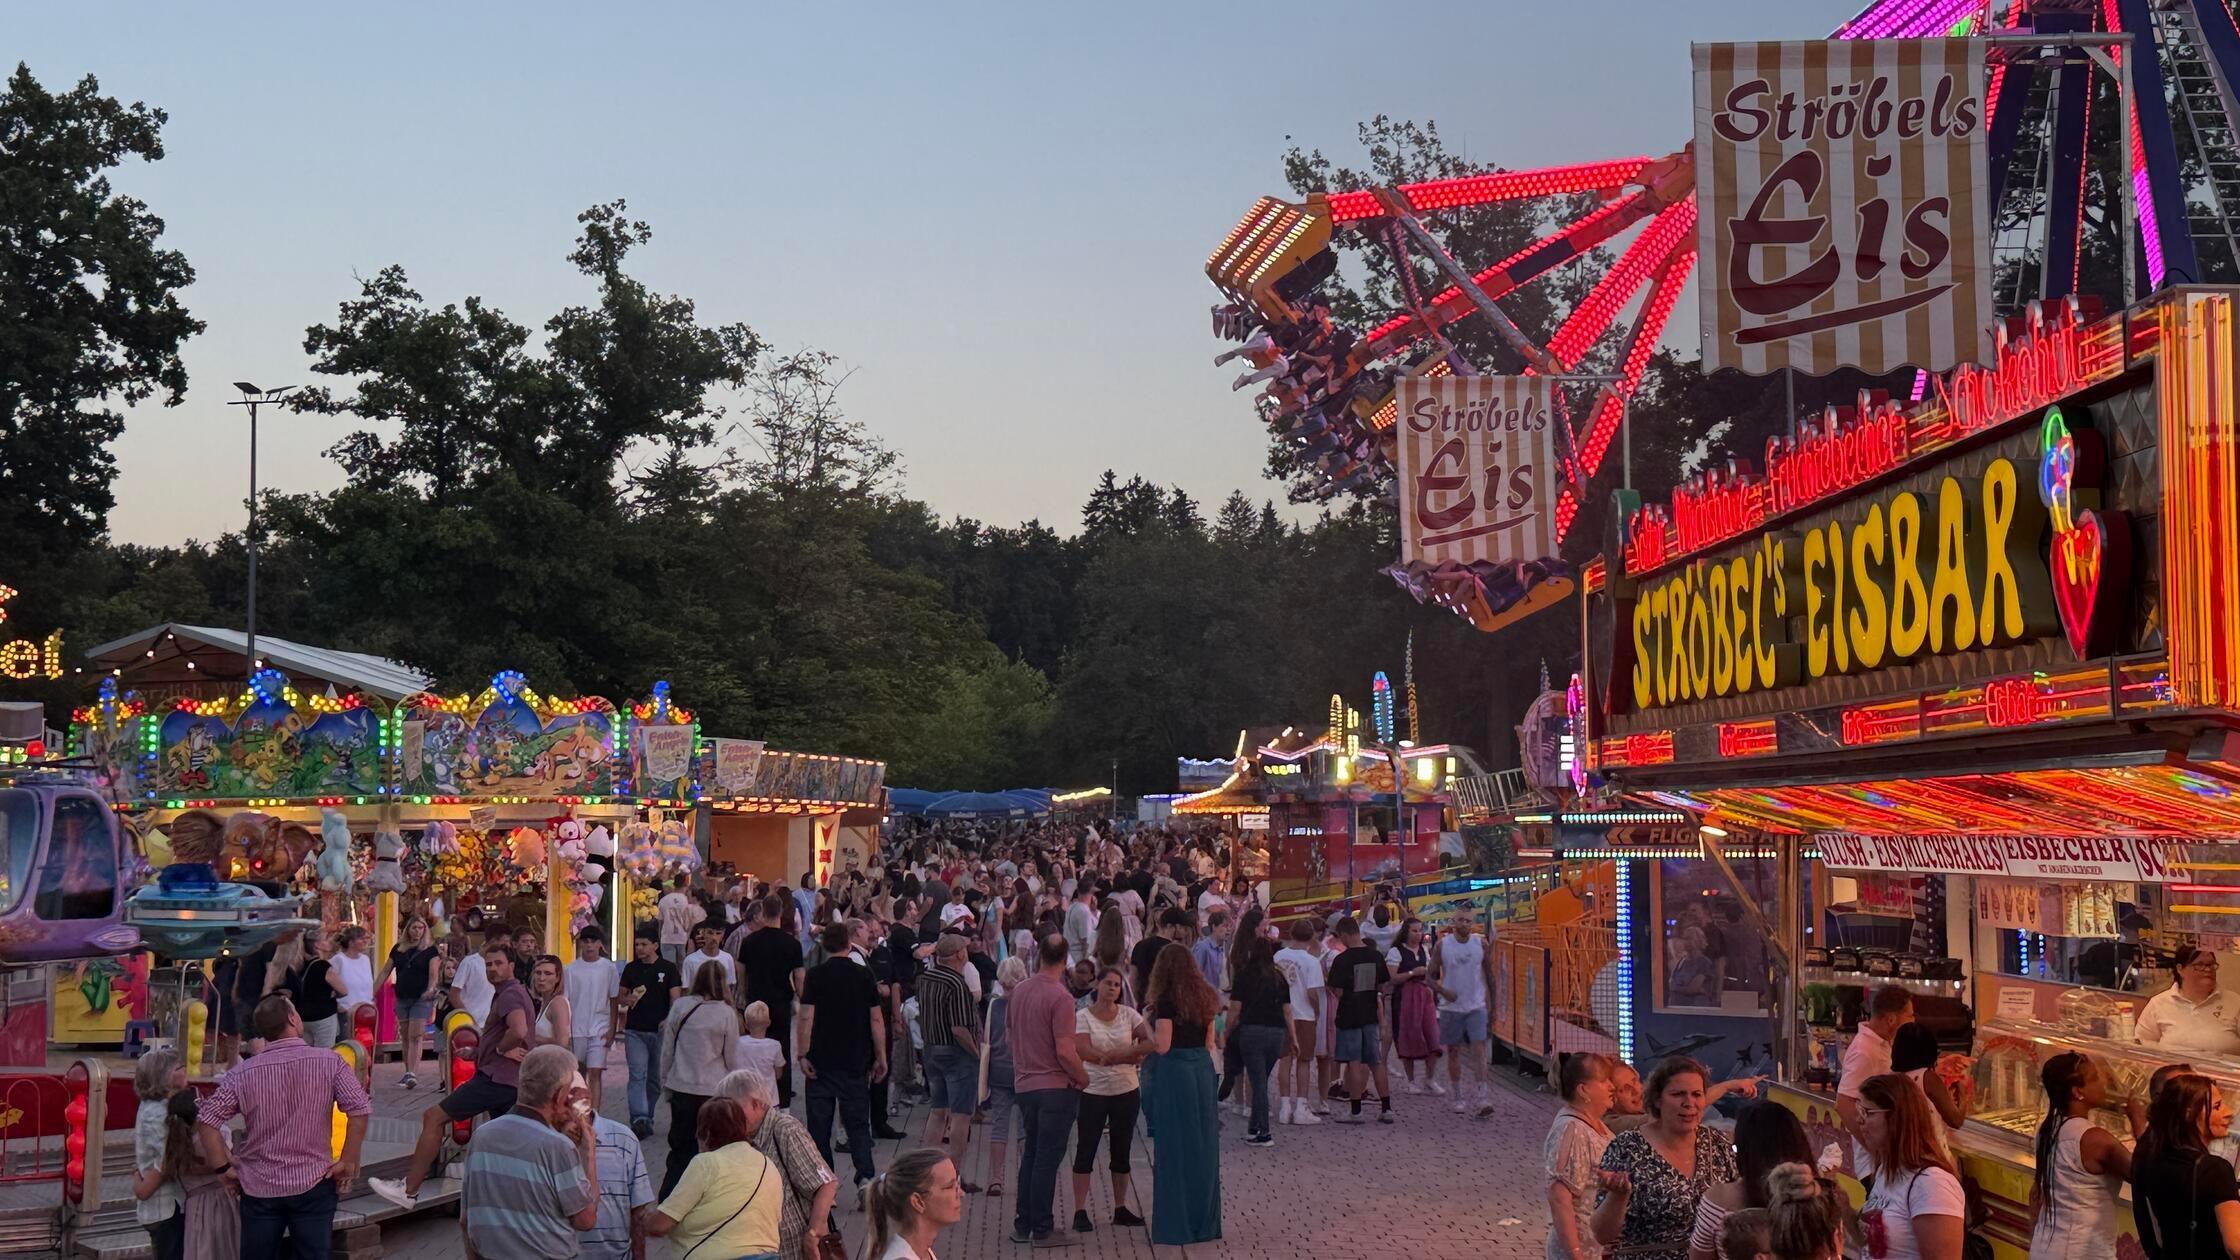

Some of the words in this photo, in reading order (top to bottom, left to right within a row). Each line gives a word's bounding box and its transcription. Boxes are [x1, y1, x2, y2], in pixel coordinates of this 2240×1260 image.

[1713, 73, 1979, 142] Ströbels
[1728, 150, 1952, 316] Eis
[1406, 396, 1547, 433] Ströbels
[1415, 437, 1534, 530] Eis
[1804, 458, 2024, 679] EISBAR
[1818, 834, 1870, 867] SLUSH
[1872, 835, 1903, 868] EIS
[1901, 835, 2004, 871] MILCHSHAKES
[2003, 837, 2131, 863] EISBECHER
